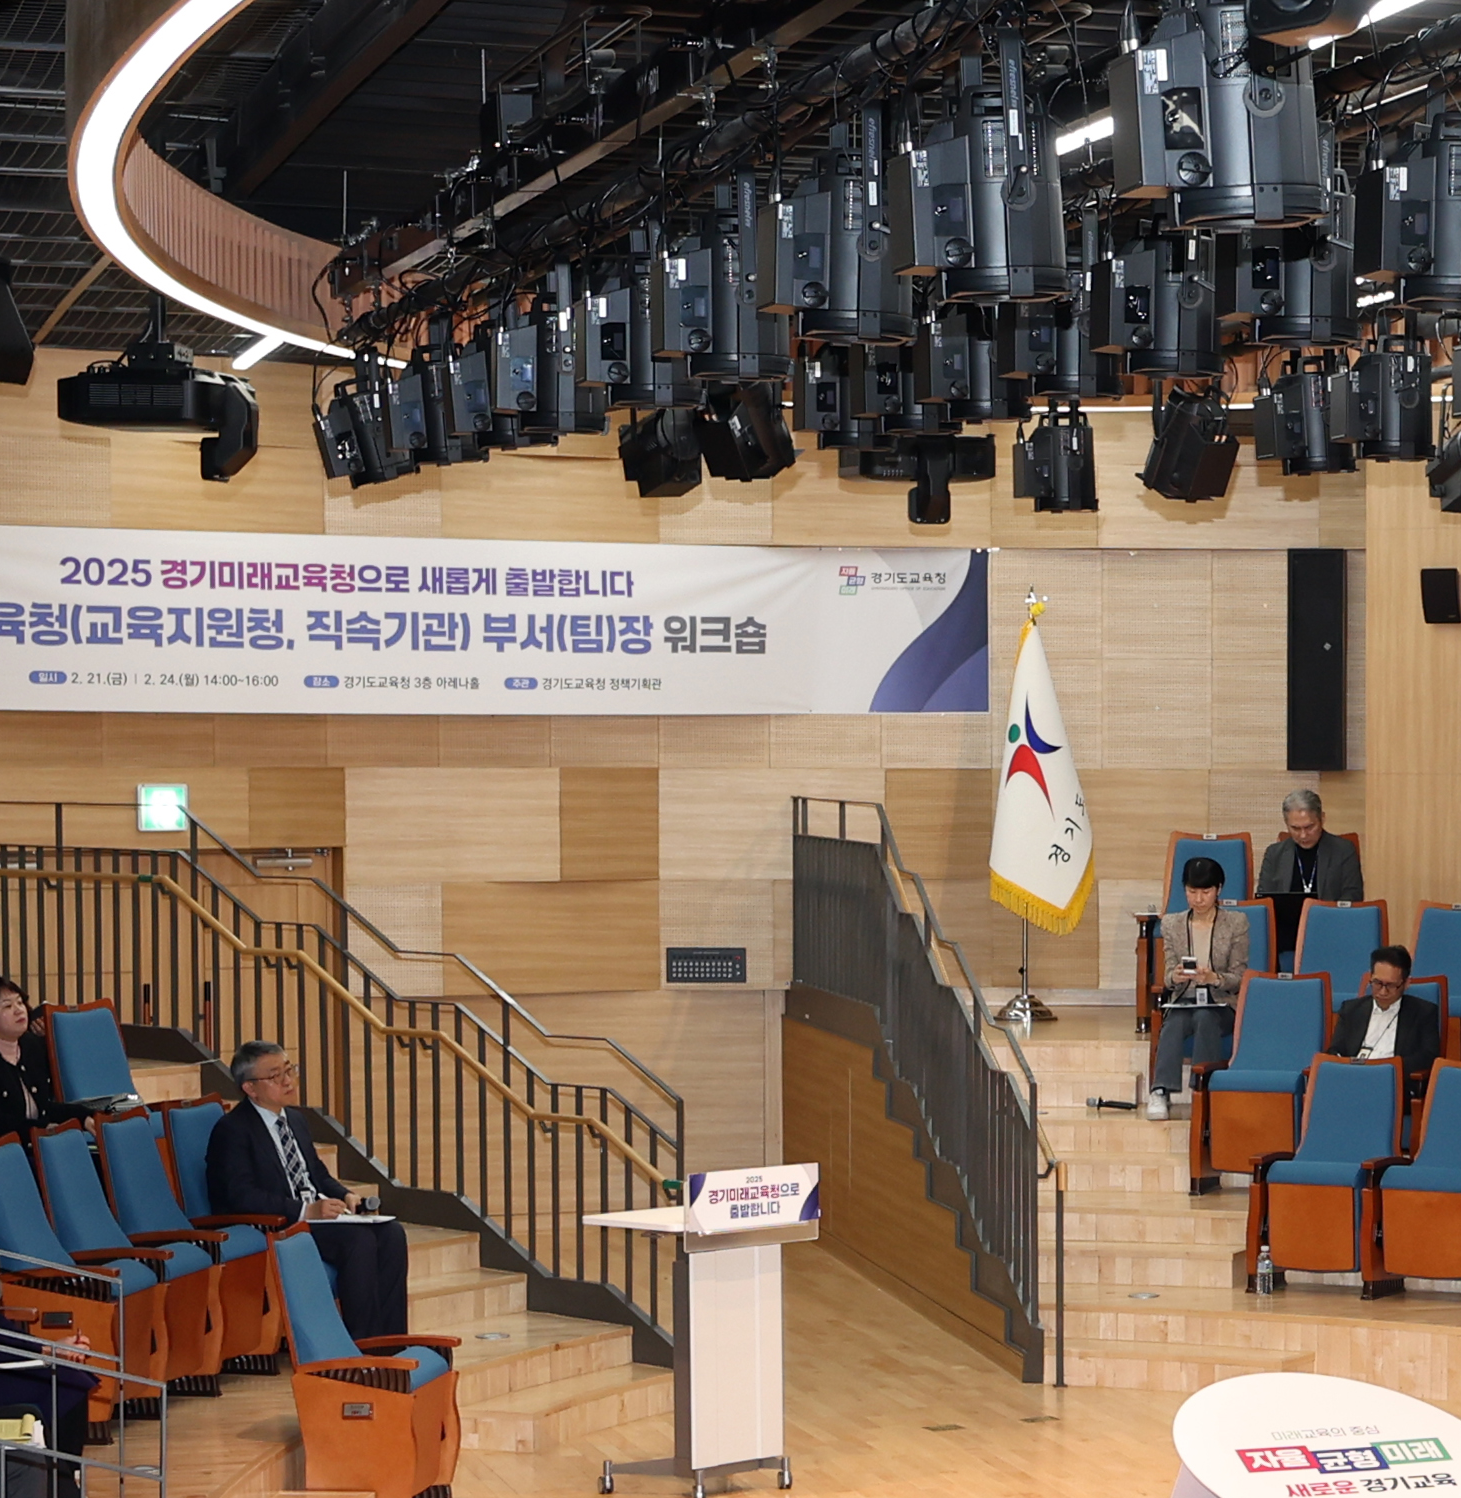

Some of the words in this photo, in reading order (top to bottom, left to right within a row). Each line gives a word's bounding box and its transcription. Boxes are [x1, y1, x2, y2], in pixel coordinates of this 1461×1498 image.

[59, 556, 153, 588] 2025
[159, 559, 410, 594] 경기미래교육청으로
[417, 566, 497, 596] 새롭게
[504, 568, 634, 598] 출발합니다
[870, 572, 947, 585] 경기도교육청
[305, 608, 471, 652] 직속기관)
[482, 613, 654, 656] 부서(팀)장
[663, 616, 768, 656] 워크숍
[71, 672, 83, 685] 2.
[87, 672, 127, 686] 21.(금)
[144, 673, 156, 686] 2.
[160, 673, 200, 687] 24.(월)
[203, 675, 280, 687] 14:00~16:00
[344, 676, 411, 690] 경기도교육청
[414, 677, 433, 690] 3층
[436, 677, 480, 690] 아레나홀
[542, 678, 606, 691] 경기도교육청
[609, 678, 662, 691] 정책기획관
[746, 1176, 763, 1184] 2025
[708, 1183, 800, 1204] 경기미래교육청으로
[730, 1201, 781, 1219] 출발합니다
[1271, 1427, 1346, 1440] 미래교육의
[1349, 1425, 1380, 1435] 중심
[1245, 1449, 1310, 1468] 자율
[1316, 1449, 1380, 1471] 균형
[1380, 1441, 1444, 1461] 미래
[1286, 1480, 1359, 1497] 새로운
[1360, 1472, 1457, 1492] 경기교육
